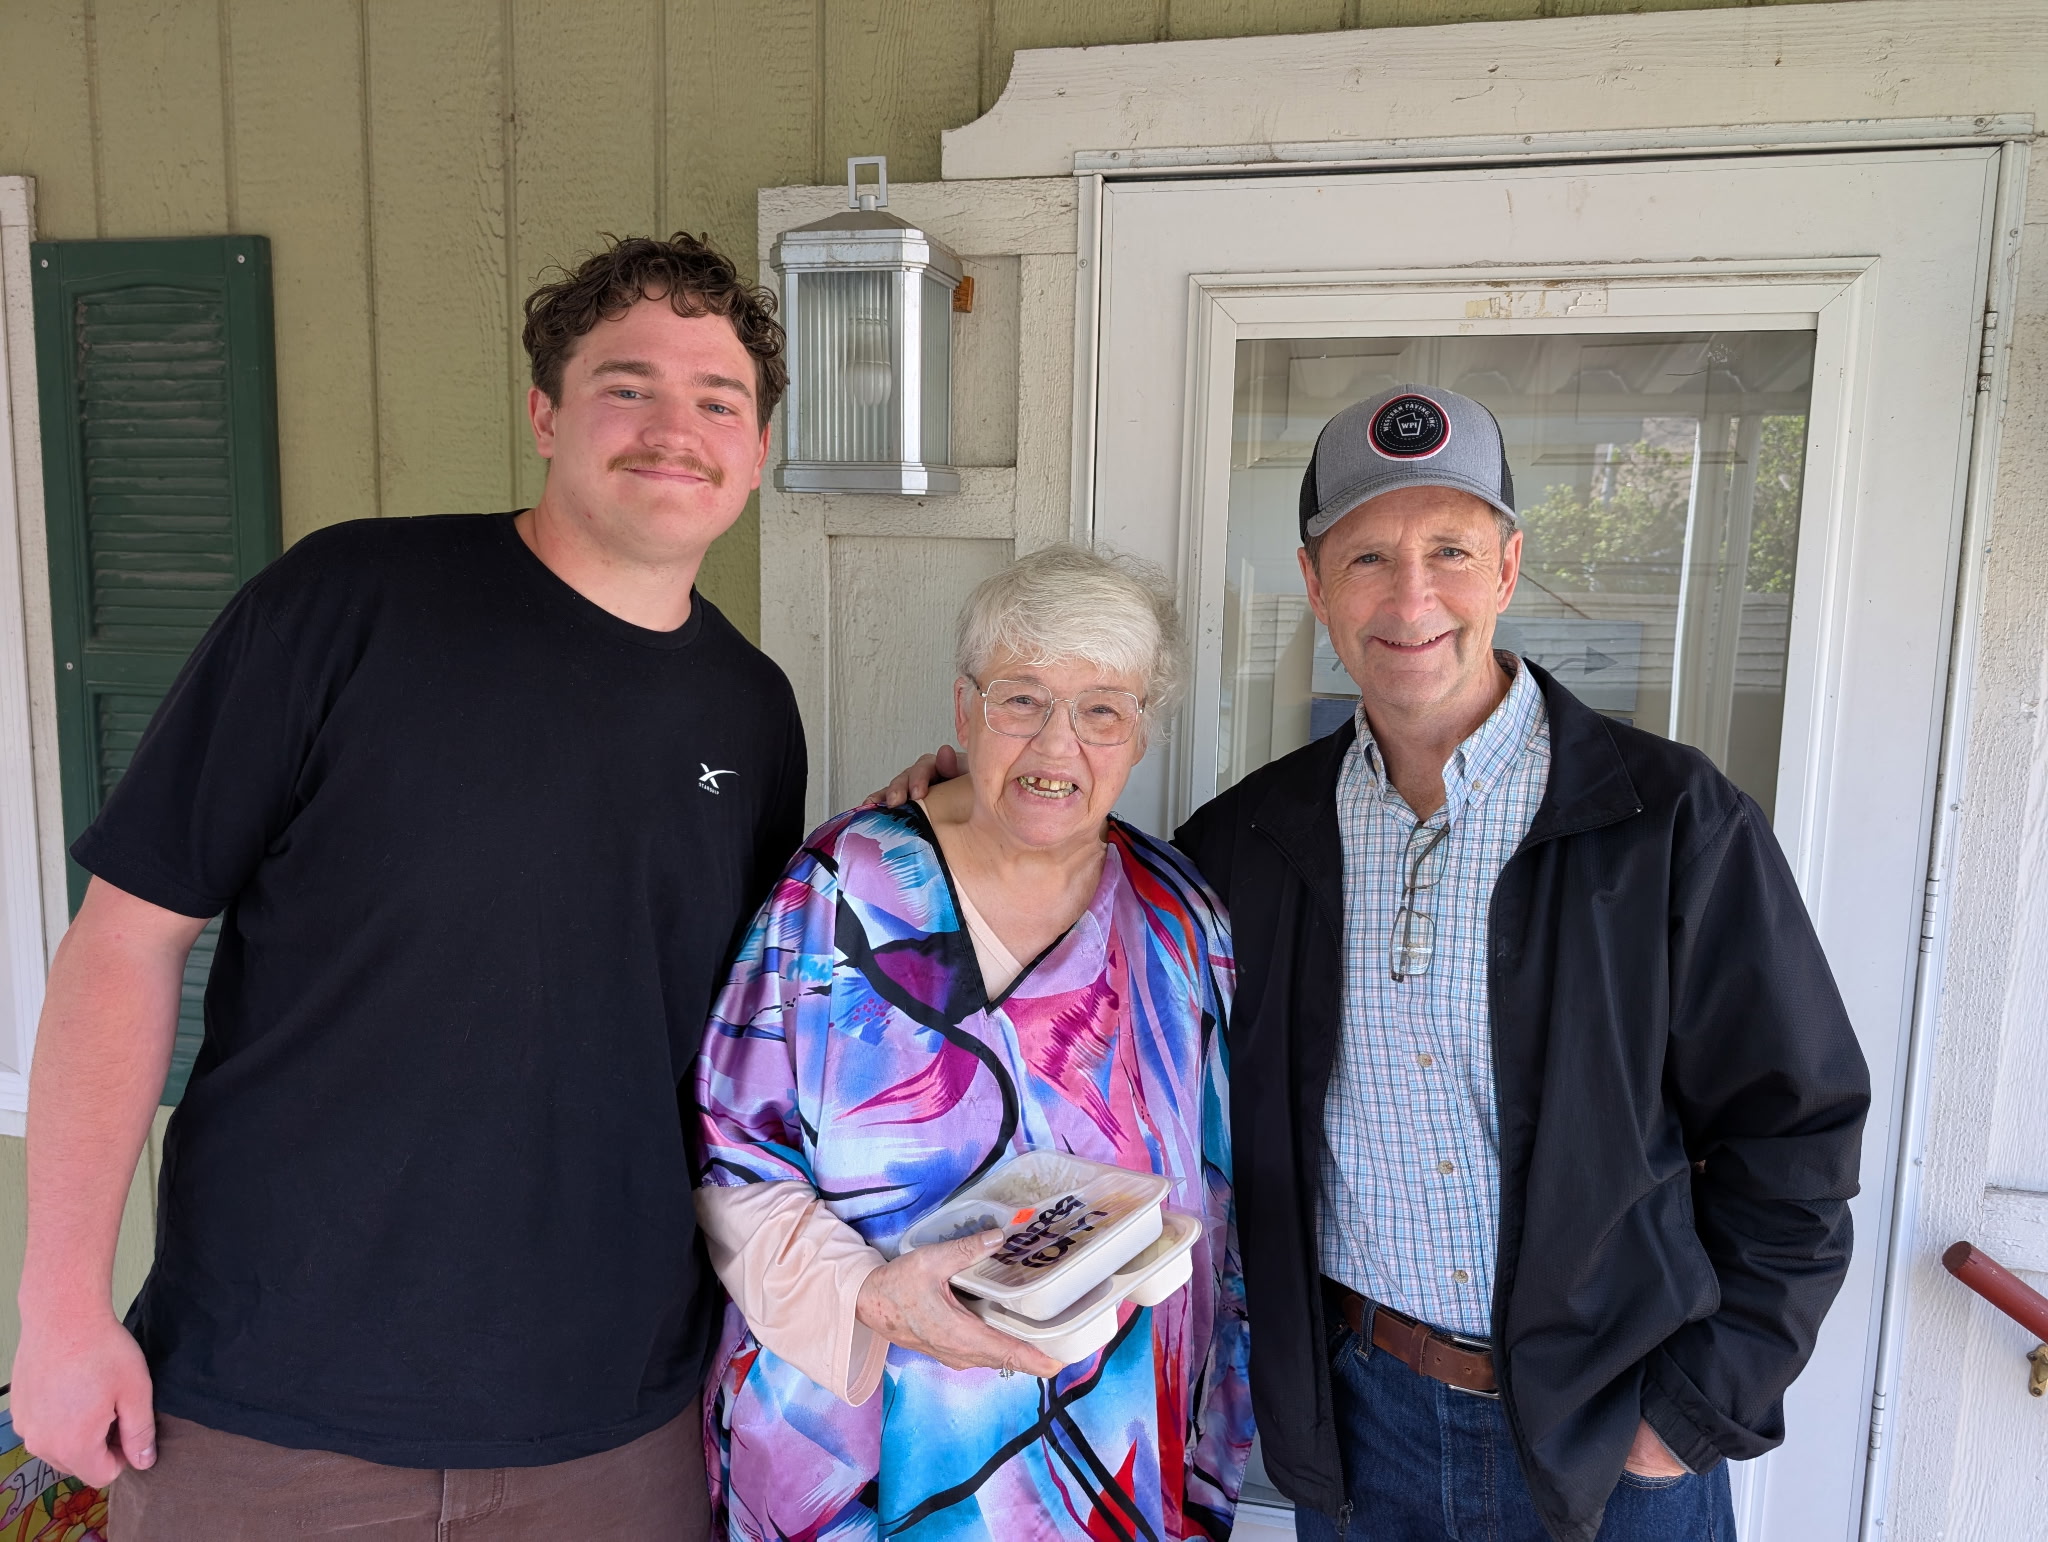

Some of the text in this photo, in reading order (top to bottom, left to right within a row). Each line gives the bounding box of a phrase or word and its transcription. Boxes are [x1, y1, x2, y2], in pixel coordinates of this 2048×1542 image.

[1382, 405, 1404, 433] WESTERN
[1400, 421, 1418, 430] WPI
[698, 781, 720, 796] STARSHIP
